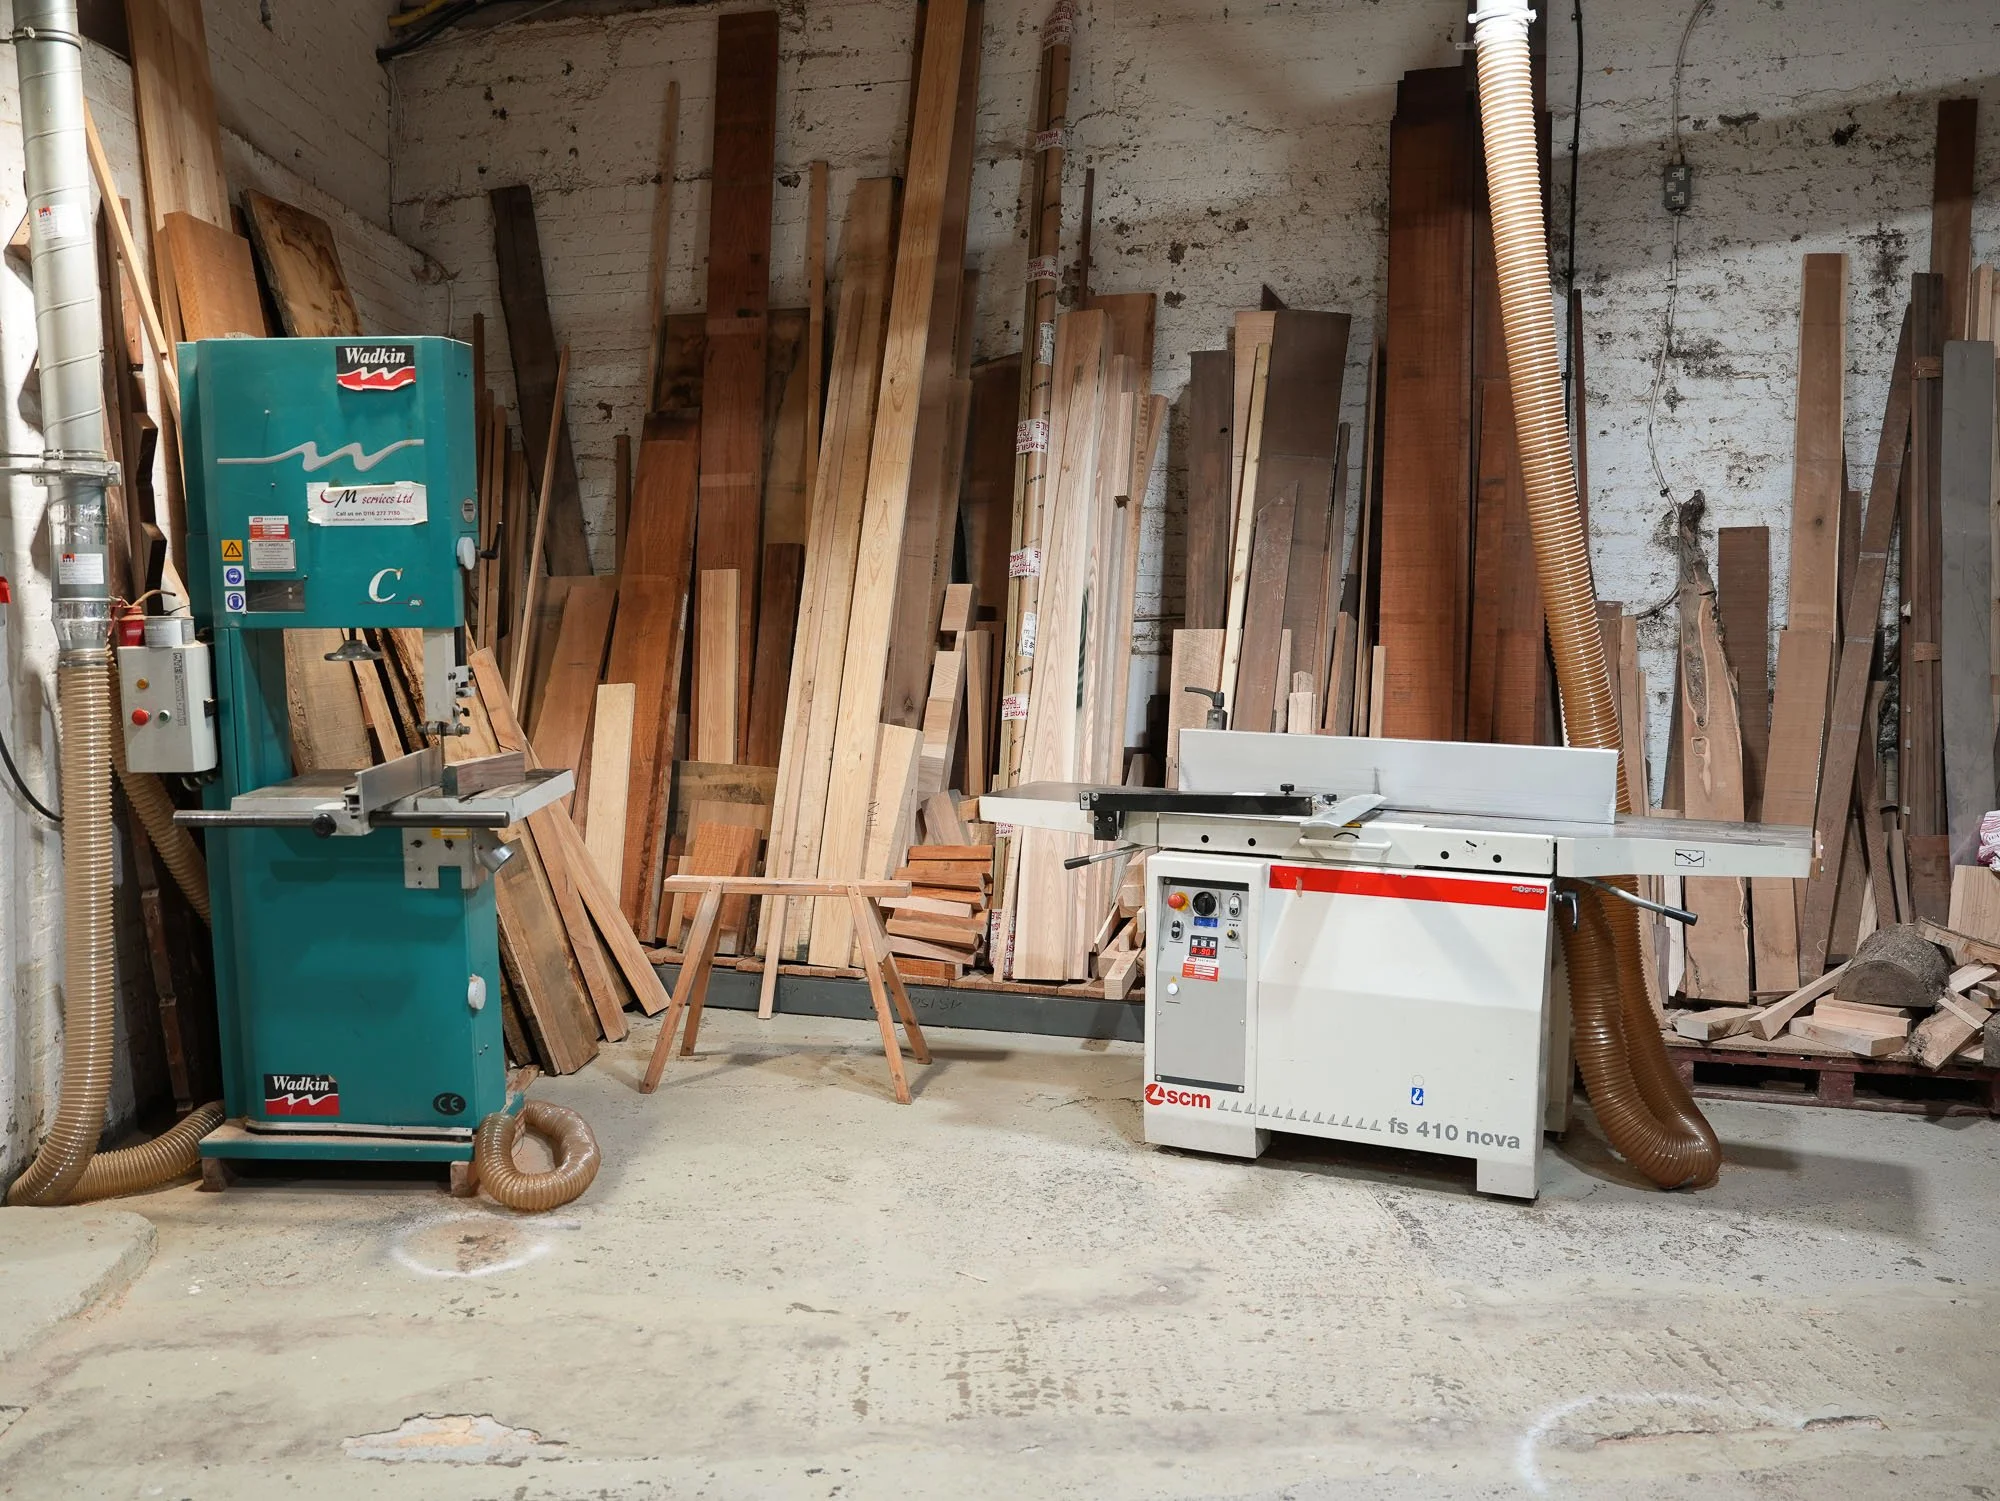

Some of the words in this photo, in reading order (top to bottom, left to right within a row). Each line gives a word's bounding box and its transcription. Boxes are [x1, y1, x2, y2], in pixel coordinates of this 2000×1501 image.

[345, 347, 406, 364] Wadkin
[361, 493, 395, 505] services
[396, 492, 414, 504] Ltd
[368, 568, 403, 603] C
[272, 1075, 329, 1091] Wadkin
[438, 1096, 460, 1111] CE
[1166, 1090, 1211, 1109] scm
[1388, 1117, 1409, 1135] fs
[1416, 1121, 1459, 1141] 410
[1466, 1130, 1520, 1149] nova
